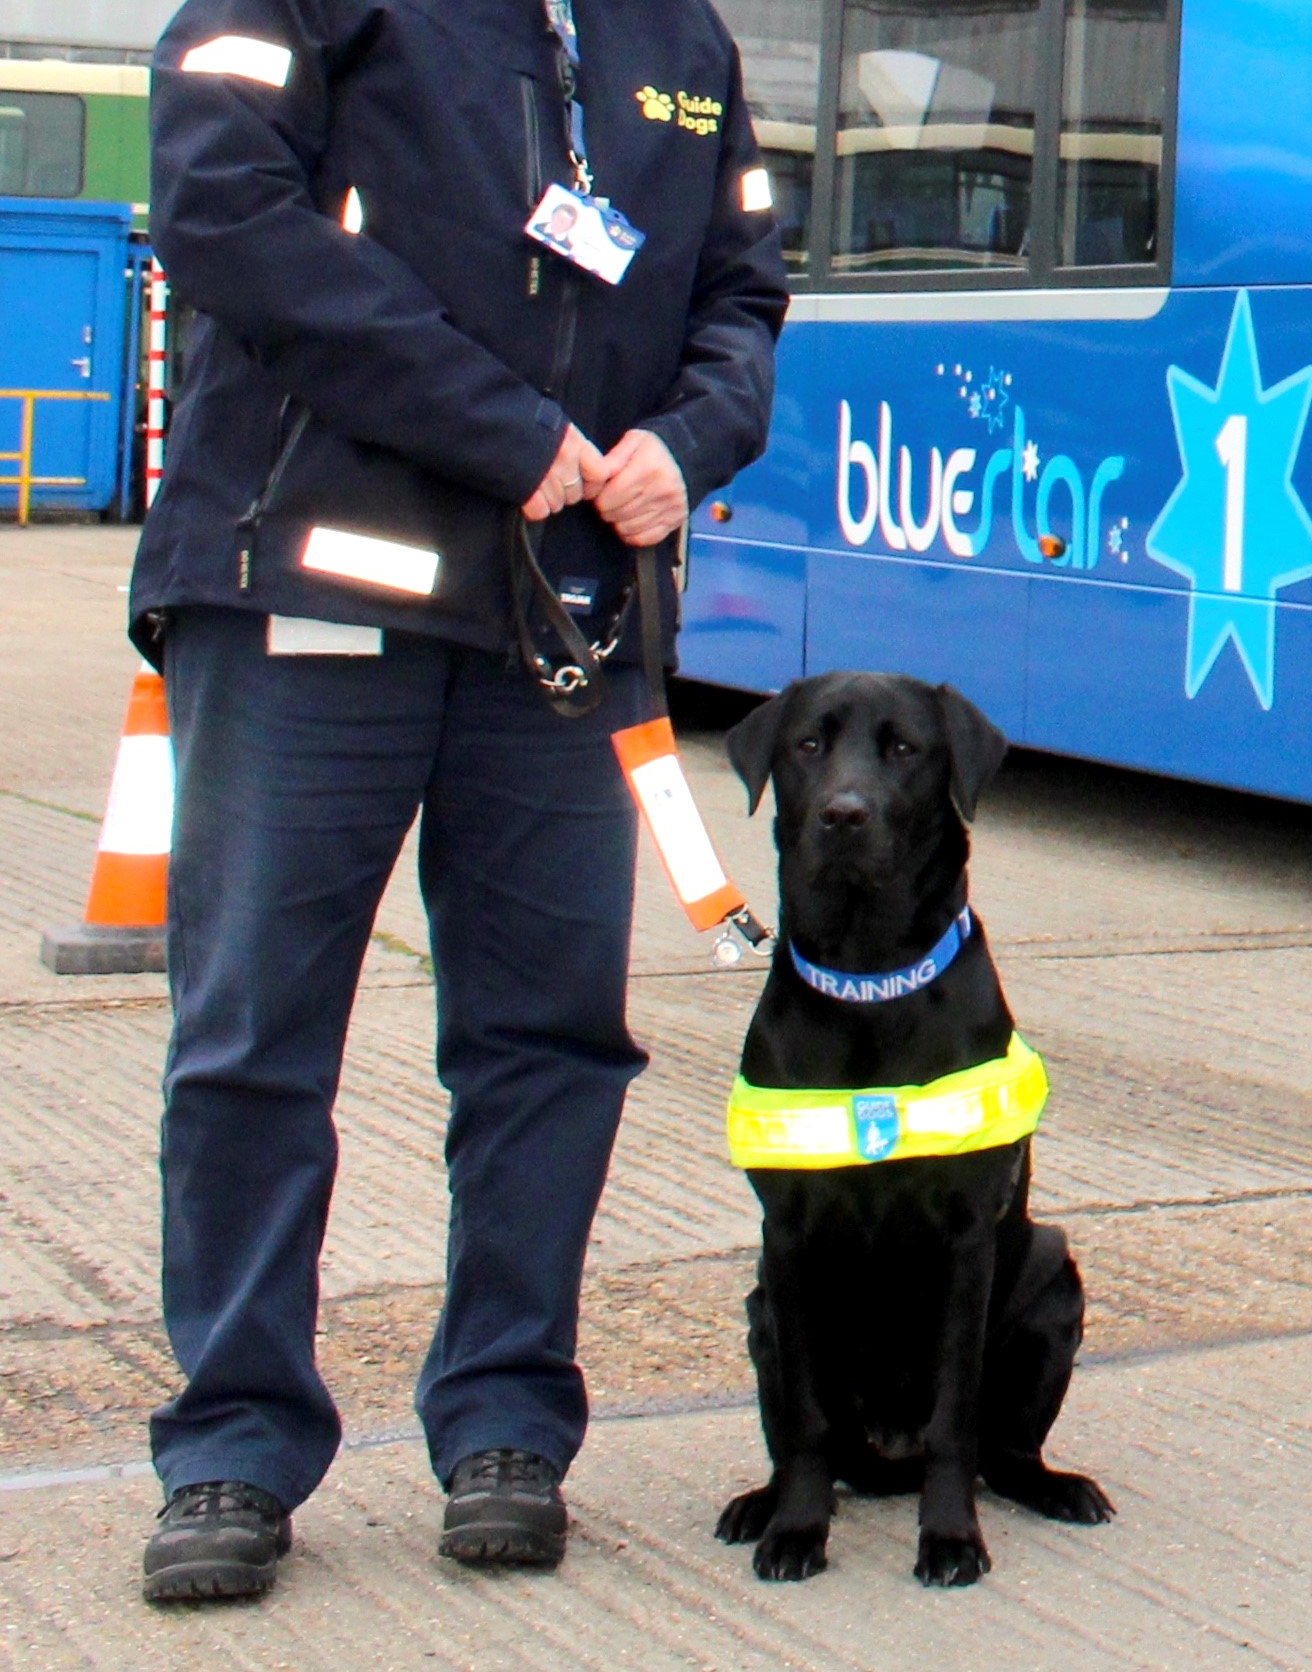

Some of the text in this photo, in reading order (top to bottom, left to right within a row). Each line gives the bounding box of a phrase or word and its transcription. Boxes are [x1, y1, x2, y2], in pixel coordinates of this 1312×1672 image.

[838, 398, 1126, 571] bluestar
[1215, 414, 1248, 592] 1
[806, 958, 937, 1003] TRAINING
